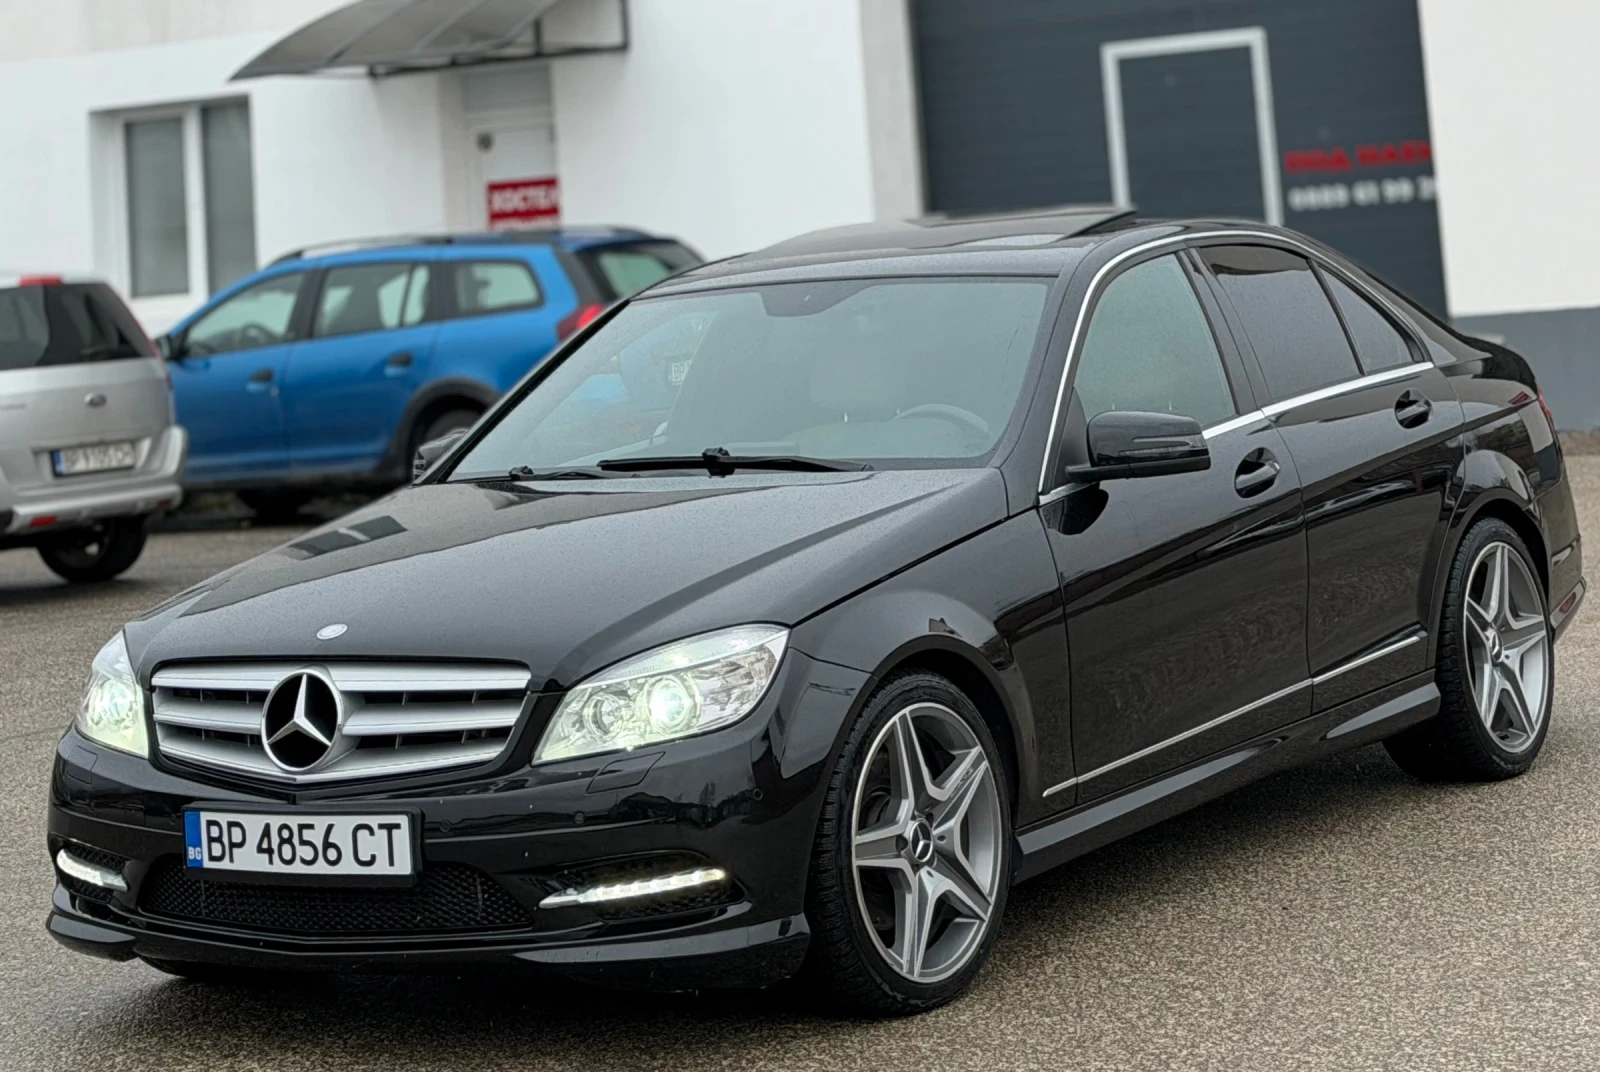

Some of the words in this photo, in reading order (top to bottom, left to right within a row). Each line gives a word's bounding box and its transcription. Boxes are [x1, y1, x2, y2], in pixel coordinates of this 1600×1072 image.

[187, 846, 202, 861] BG
[205, 819, 247, 863] BP
[256, 822, 342, 867] 4856
[351, 822, 402, 867] CT
